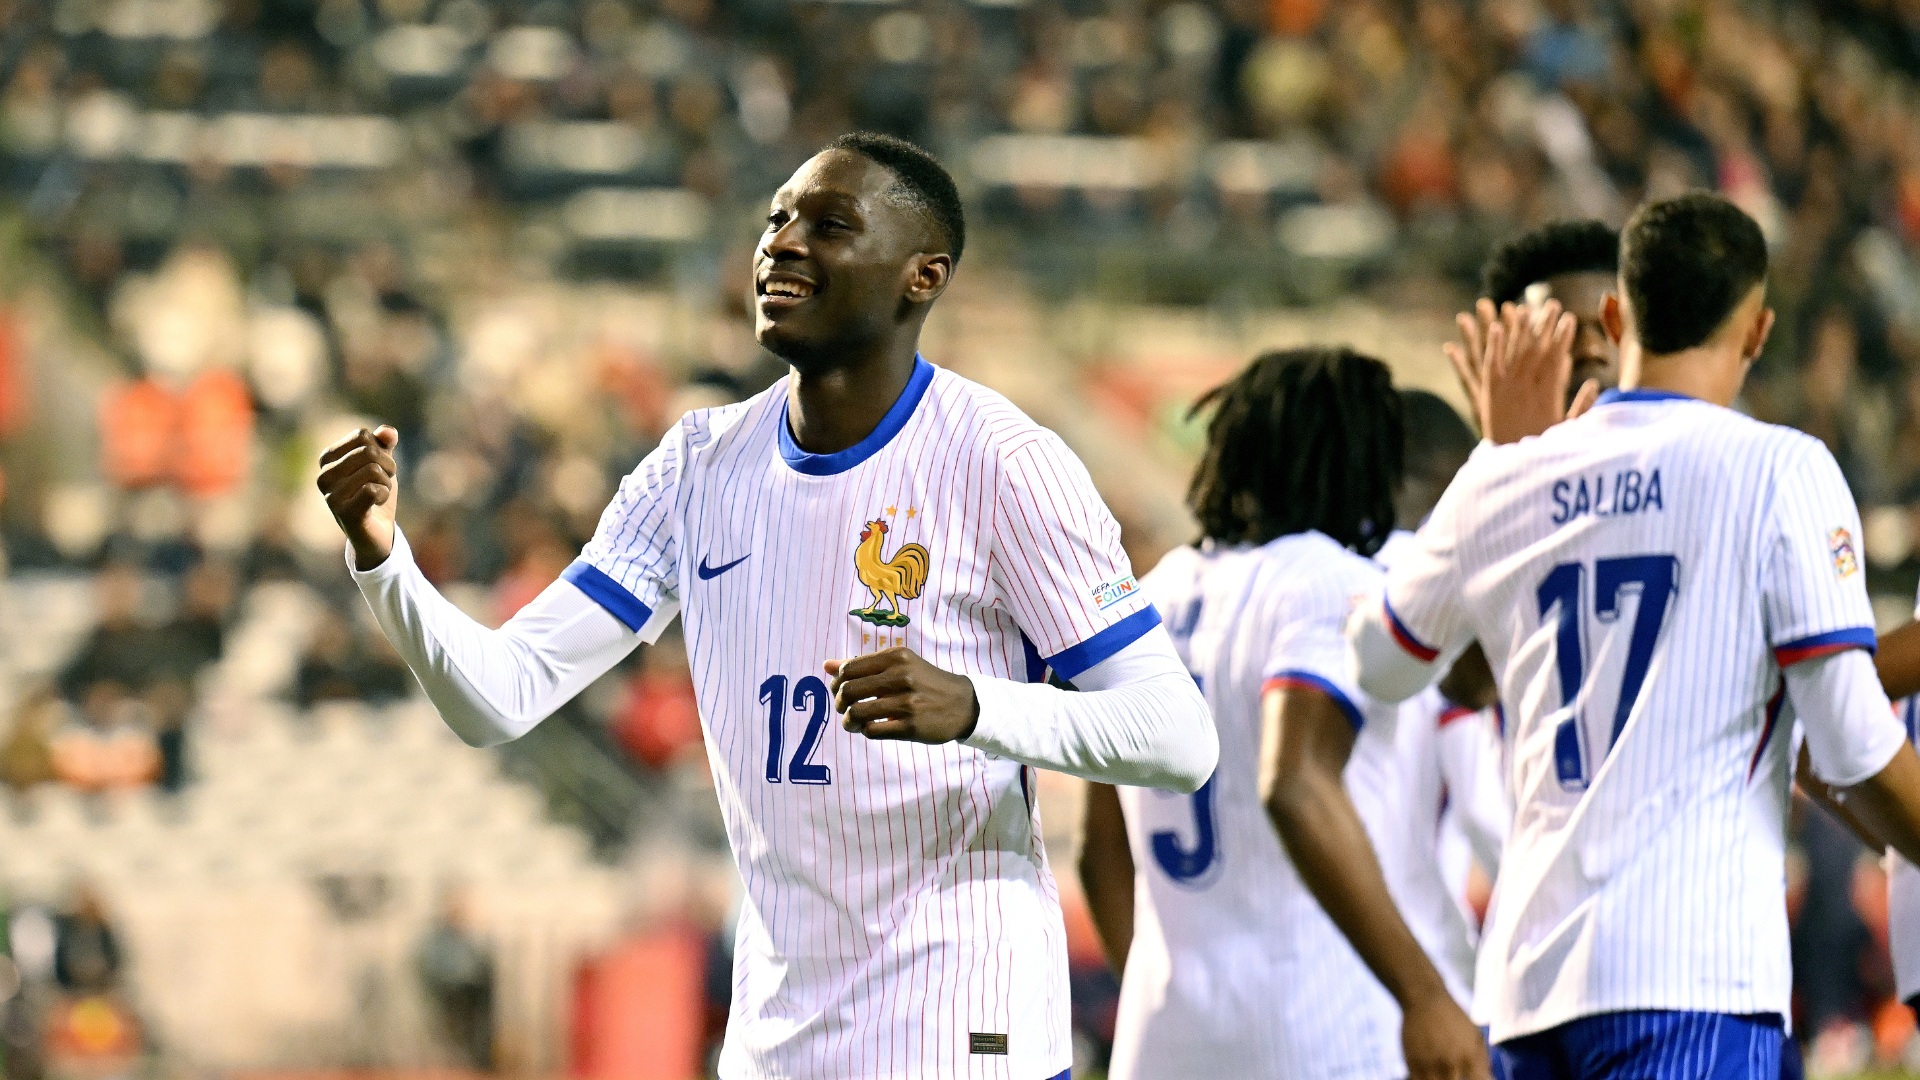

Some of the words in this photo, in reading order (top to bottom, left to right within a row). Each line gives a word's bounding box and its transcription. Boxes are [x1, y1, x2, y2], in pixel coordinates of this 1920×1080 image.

[1551, 468, 1663, 525] SALIBA
[1091, 582, 1110, 596] UEFA
[1536, 554, 1680, 792] 17
[759, 674, 831, 785] 12
